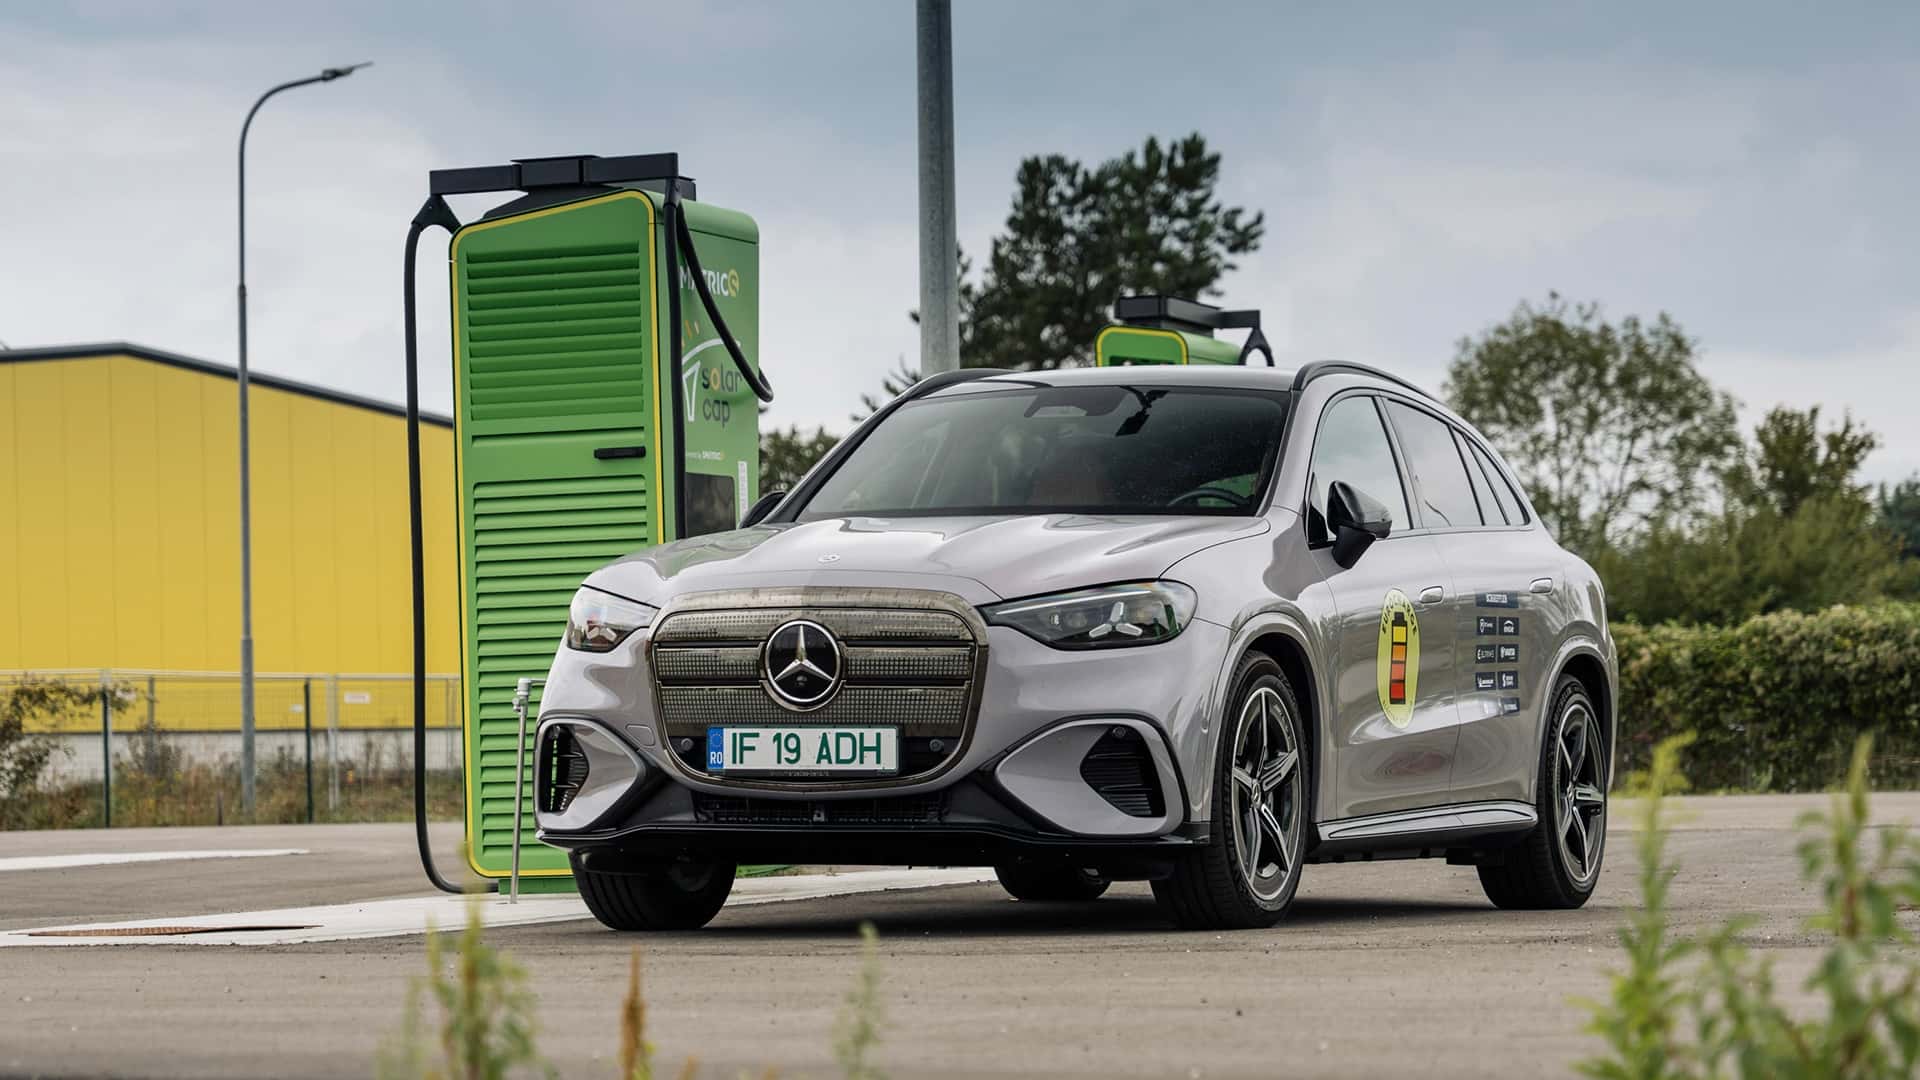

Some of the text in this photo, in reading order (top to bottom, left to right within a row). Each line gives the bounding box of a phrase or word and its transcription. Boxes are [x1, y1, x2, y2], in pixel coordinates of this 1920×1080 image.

[702, 361, 741, 393] solar
[703, 398, 730, 428] cap
[710, 751, 723, 765] RO
[732, 732, 882, 765] IF 19 ADH
